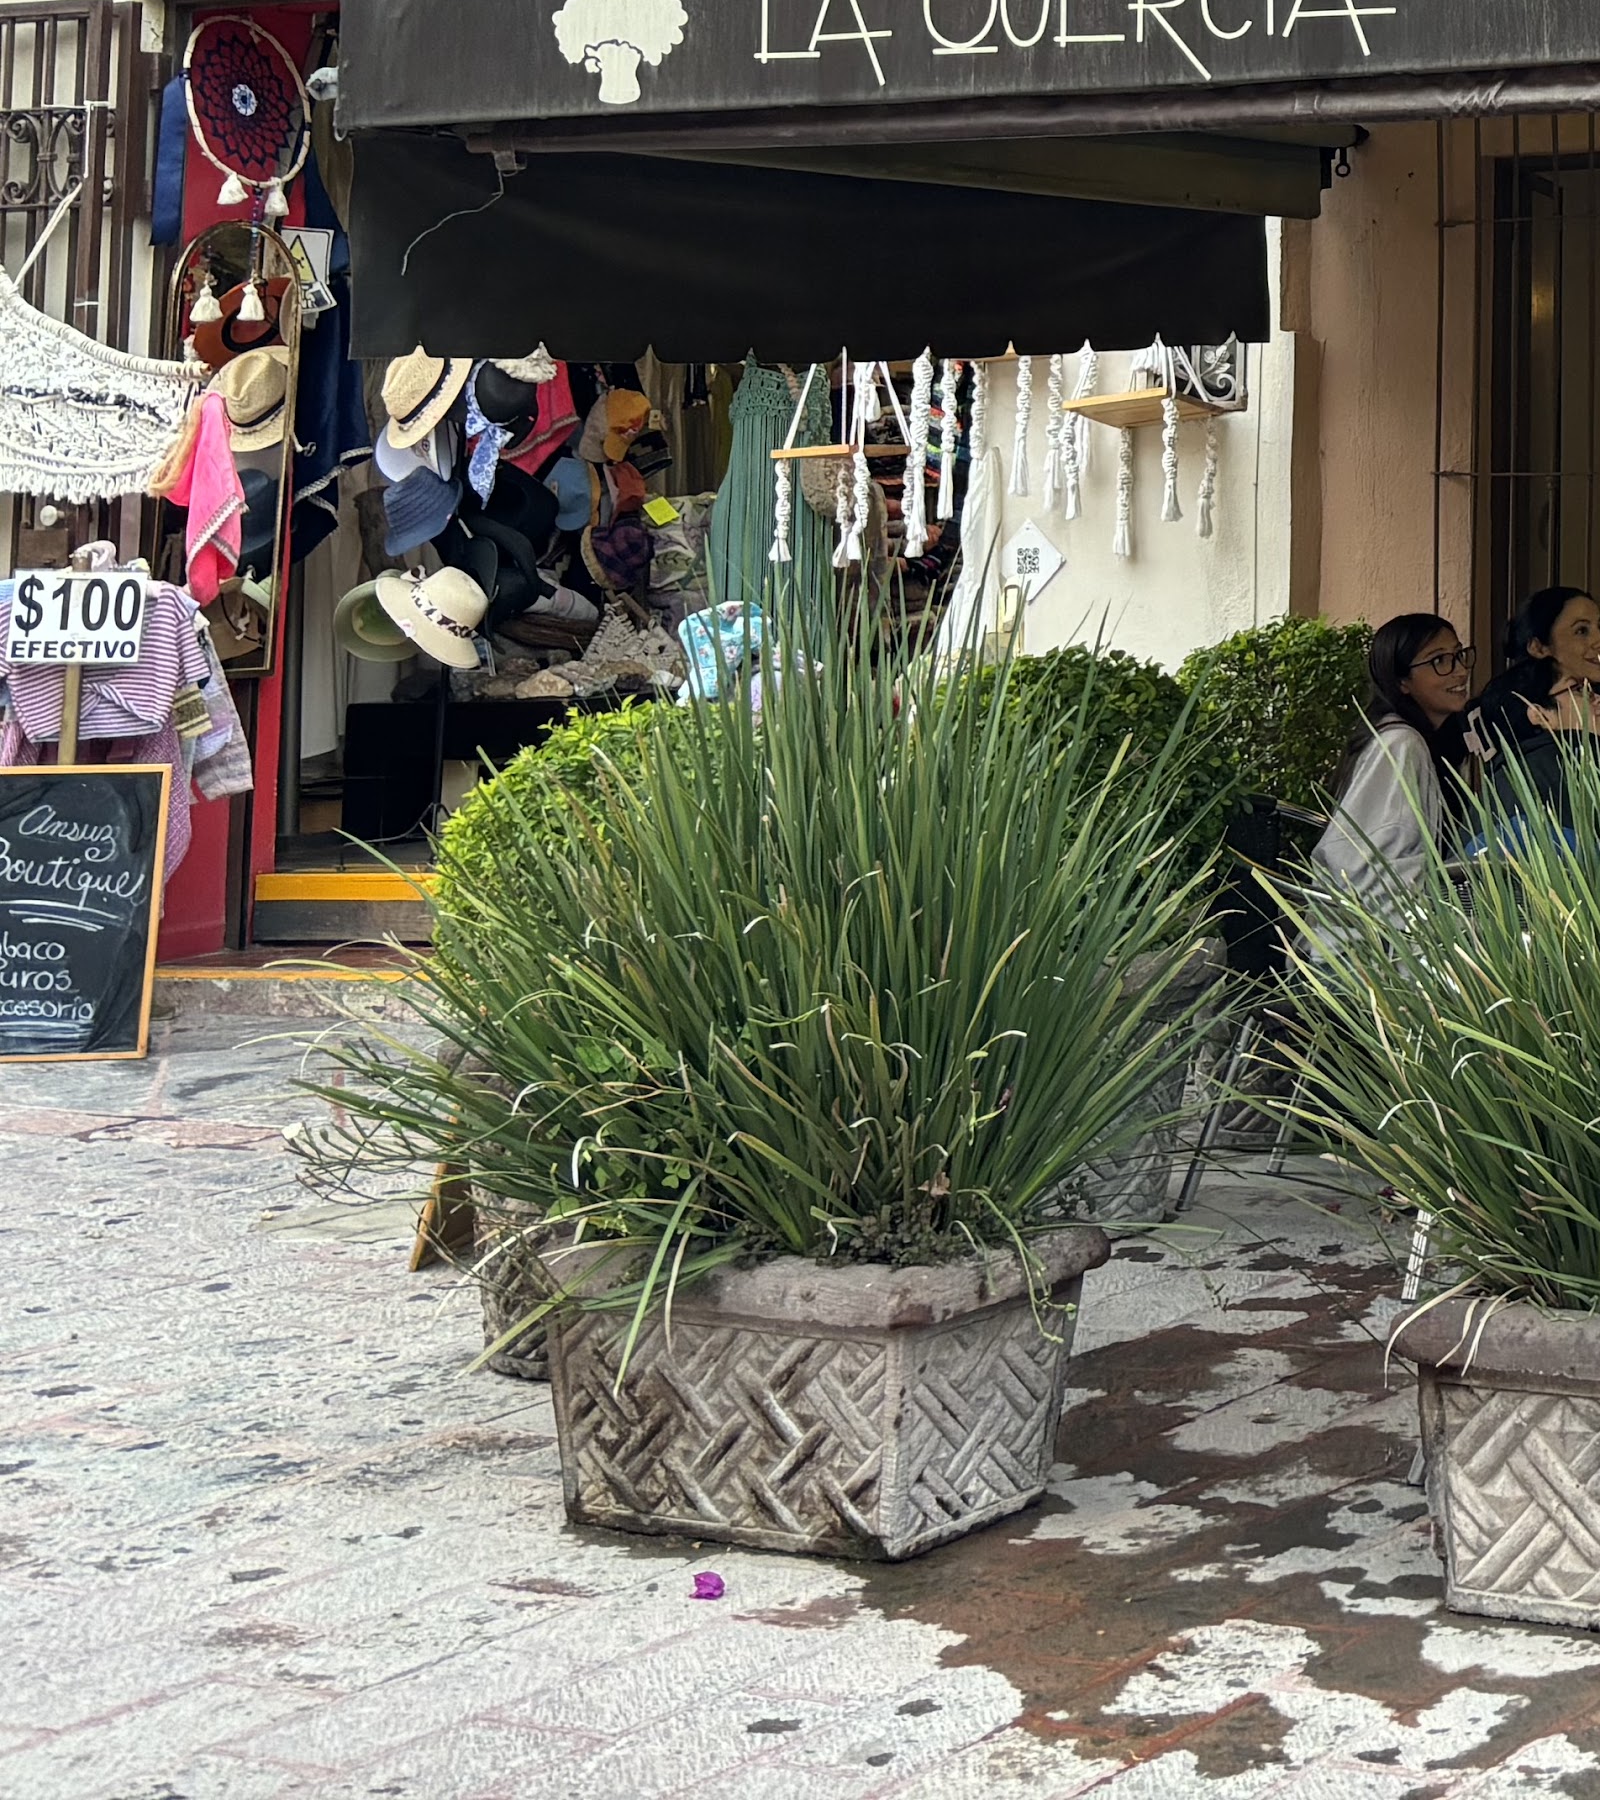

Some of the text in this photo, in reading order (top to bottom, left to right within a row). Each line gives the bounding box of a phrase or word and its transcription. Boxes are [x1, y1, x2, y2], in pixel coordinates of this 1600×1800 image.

[14, 574, 141, 638] $100
[10, 640, 136, 659] EFECTIVO
[0, 930, 66, 961] baco
